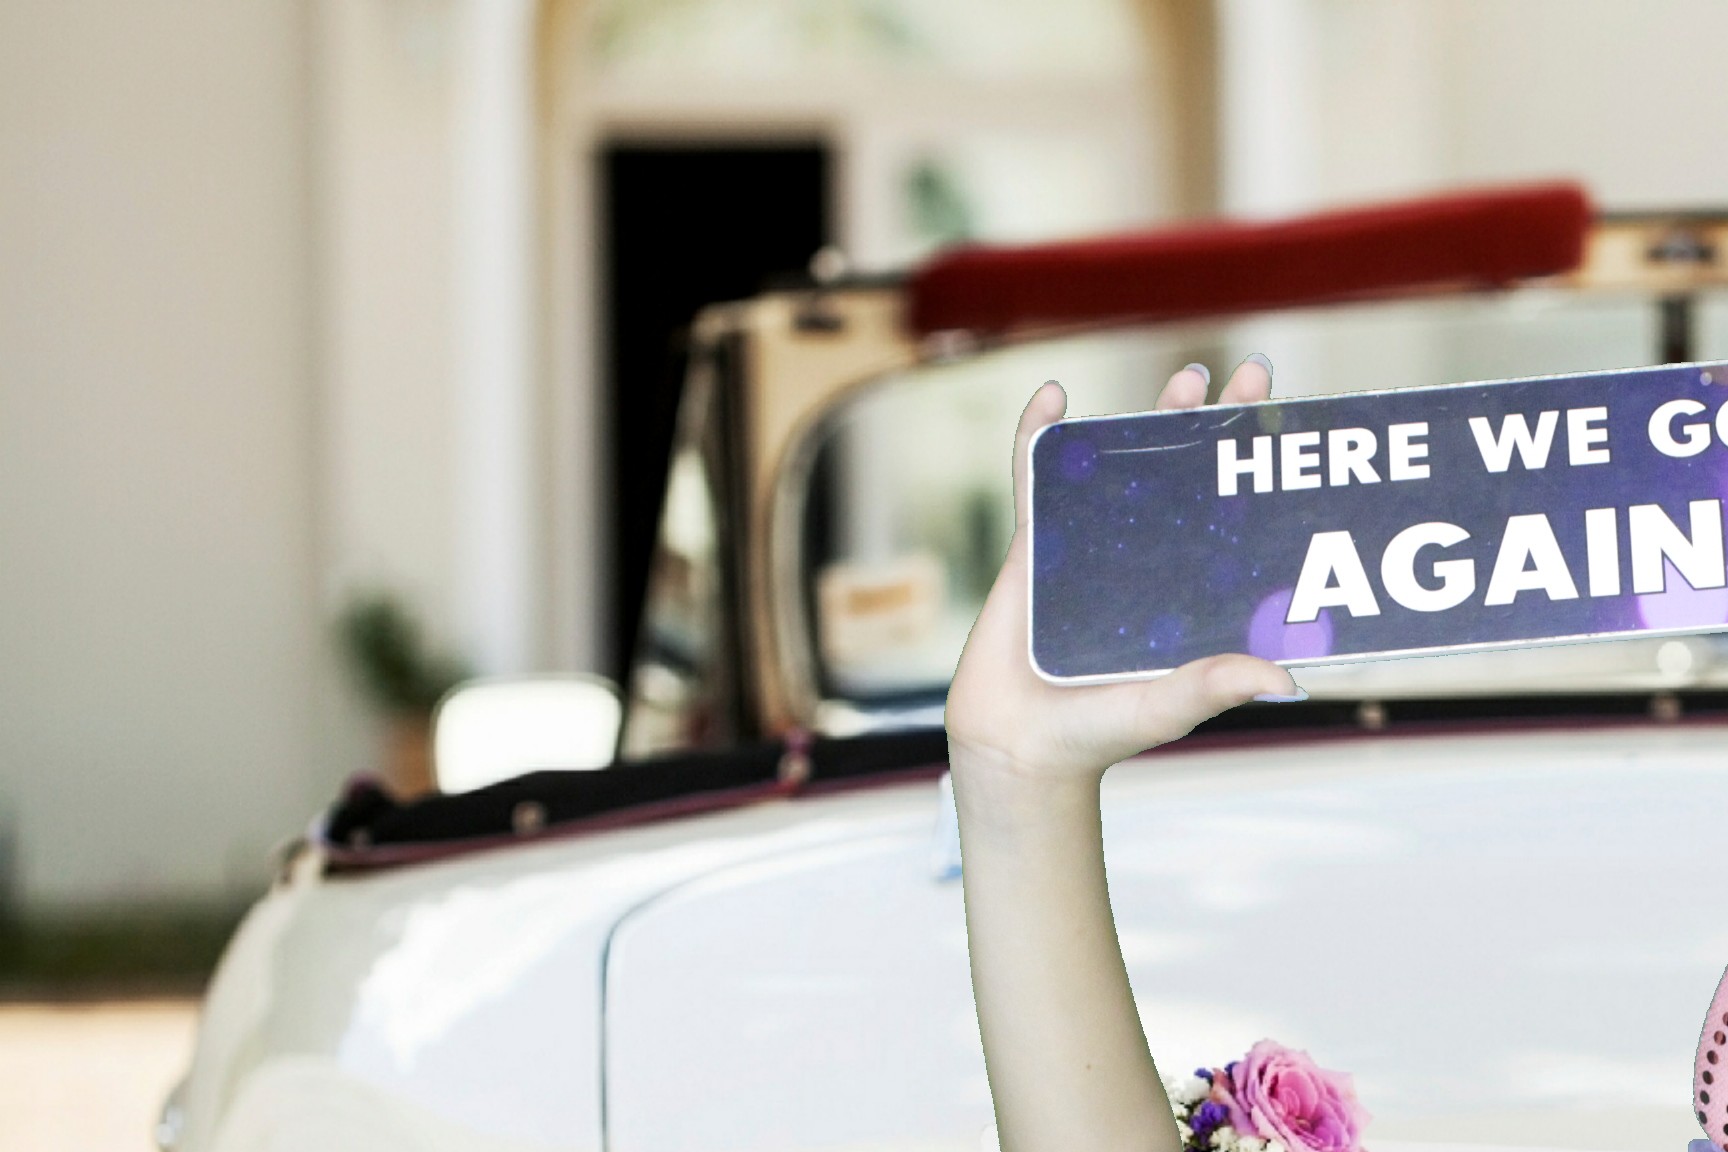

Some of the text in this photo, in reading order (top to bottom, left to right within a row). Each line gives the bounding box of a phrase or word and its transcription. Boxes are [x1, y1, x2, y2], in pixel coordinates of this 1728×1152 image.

[1216, 422, 1432, 497] HERE
[1468, 406, 1611, 474] WE
[1285, 498, 1728, 625] AGAIN
